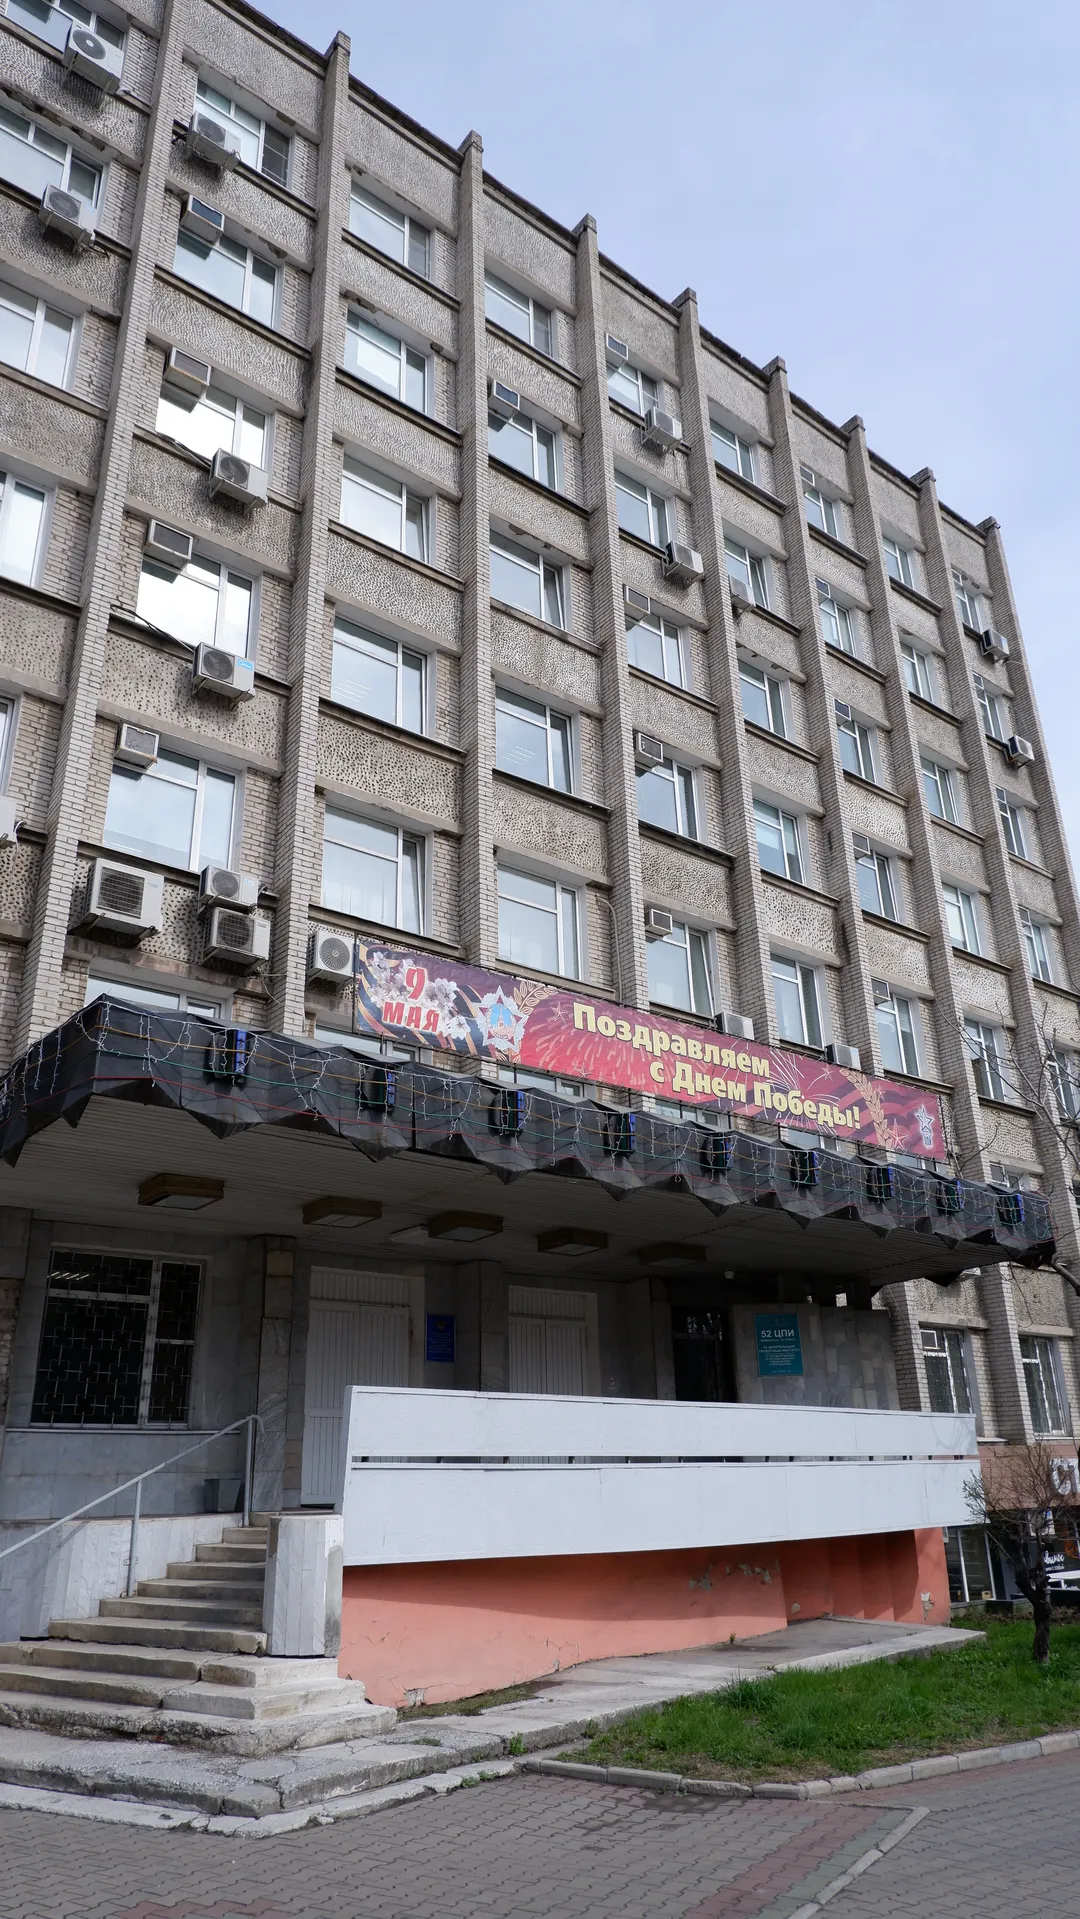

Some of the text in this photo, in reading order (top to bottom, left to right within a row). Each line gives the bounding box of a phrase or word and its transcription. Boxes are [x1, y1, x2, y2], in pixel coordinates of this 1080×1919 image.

[405, 967, 427, 1001] 9
[382, 1001, 440, 1033] МАЯ
[573, 1001, 770, 1079] Поздравляем
[649, 1060, 861, 1130] с Днем Победы!
[761, 1329, 795, 1338] 52 ЦПИ
